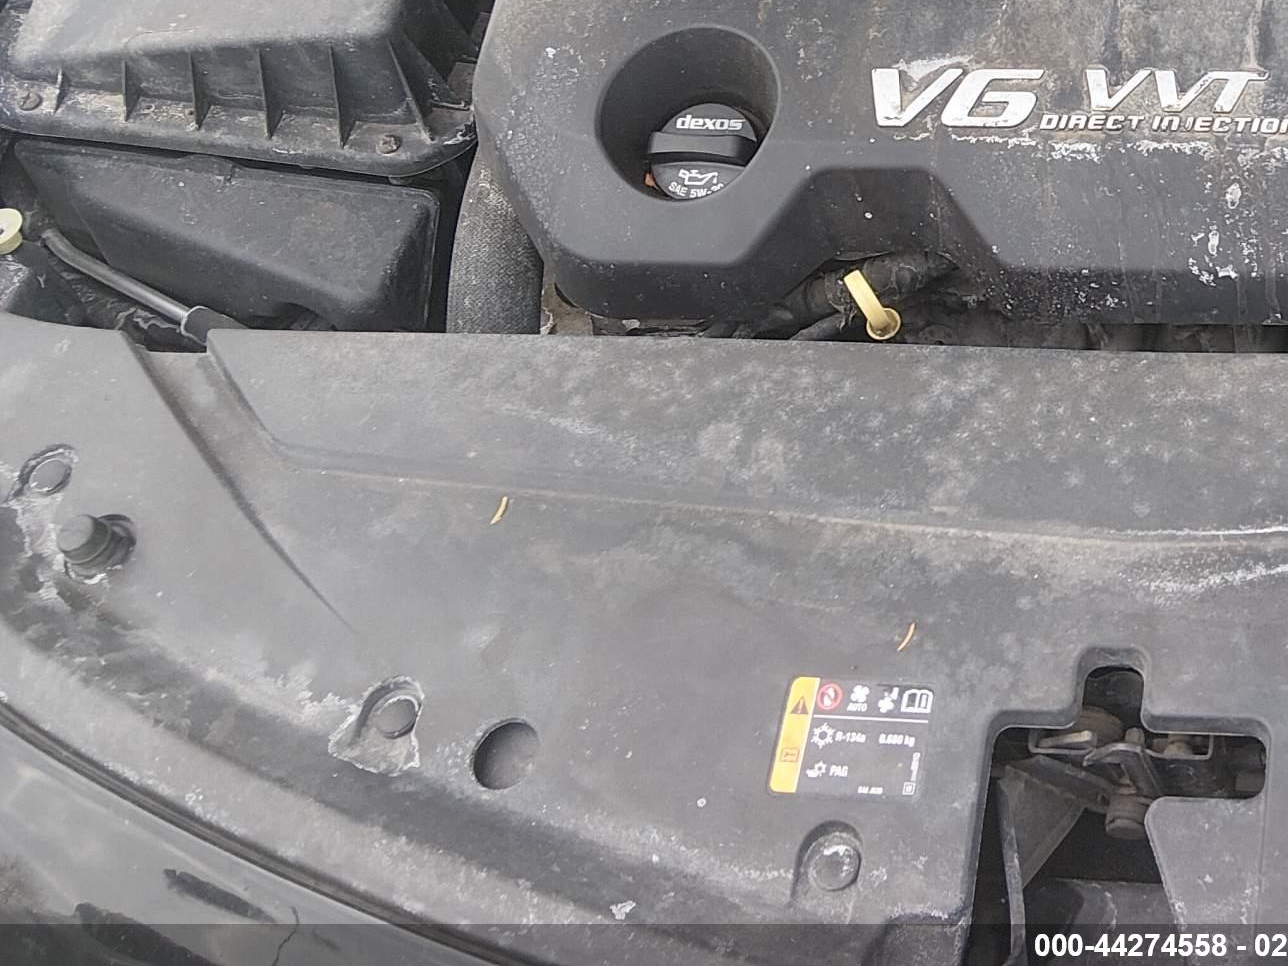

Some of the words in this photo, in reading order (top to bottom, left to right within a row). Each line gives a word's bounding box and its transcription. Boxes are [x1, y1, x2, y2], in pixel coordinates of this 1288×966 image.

[871, 68, 1044, 127] V6
[1084, 69, 1270, 113] VVT
[676, 115, 745, 130] dexos
[1040, 114, 1145, 131] DIRECT
[668, 182, 688, 196] SAE
[847, 703, 868, 711] AUTO
[829, 765, 848, 777] PAG
